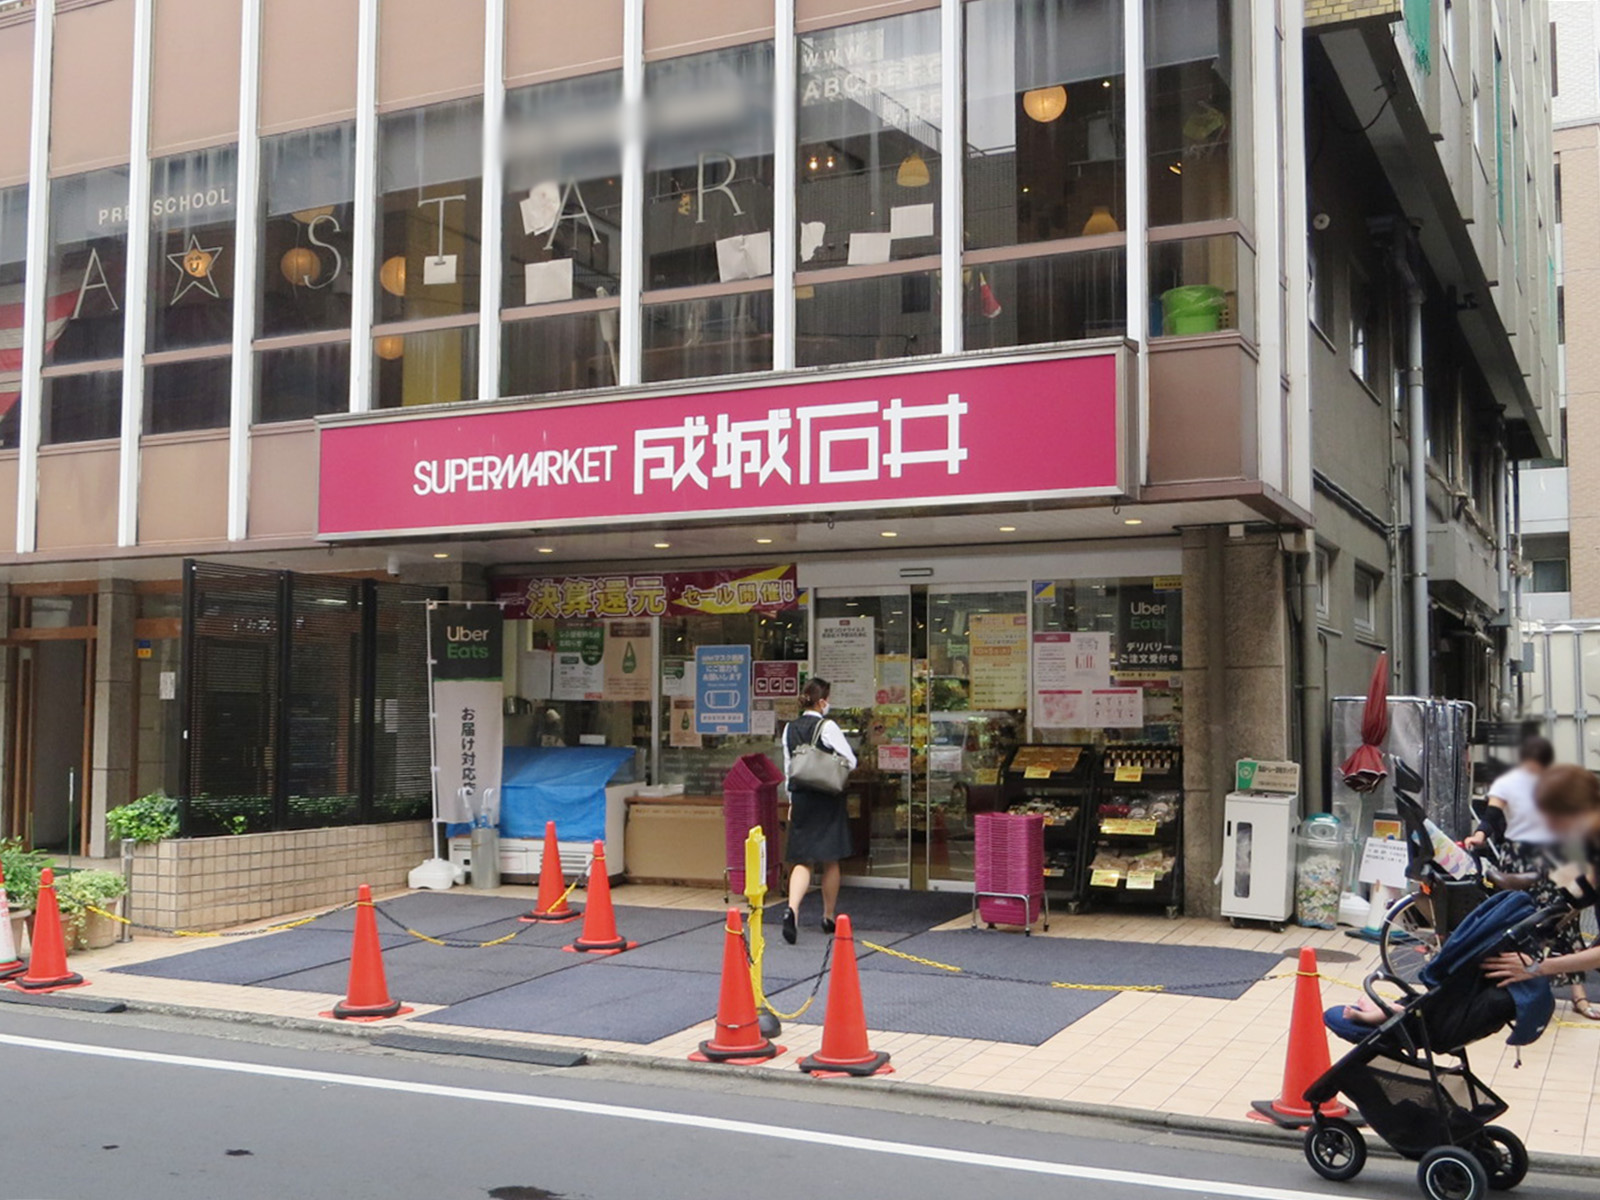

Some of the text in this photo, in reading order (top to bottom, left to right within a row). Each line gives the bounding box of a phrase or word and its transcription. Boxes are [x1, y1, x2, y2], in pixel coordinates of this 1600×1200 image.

[152, 188, 231, 217] SCHOOL
[413, 393, 968, 496] SUPERMARKET 成城石井
[526, 575, 668, 619] 決算還元
[1130, 601, 1168, 616] Uber
[1130, 615, 1168, 631] Eats
[447, 625, 490, 642] Uber
[447, 643, 490, 660] Eats
[1126, 642, 1173, 652] デリバリー
[1120, 653, 1179, 665] ご注文受付中
